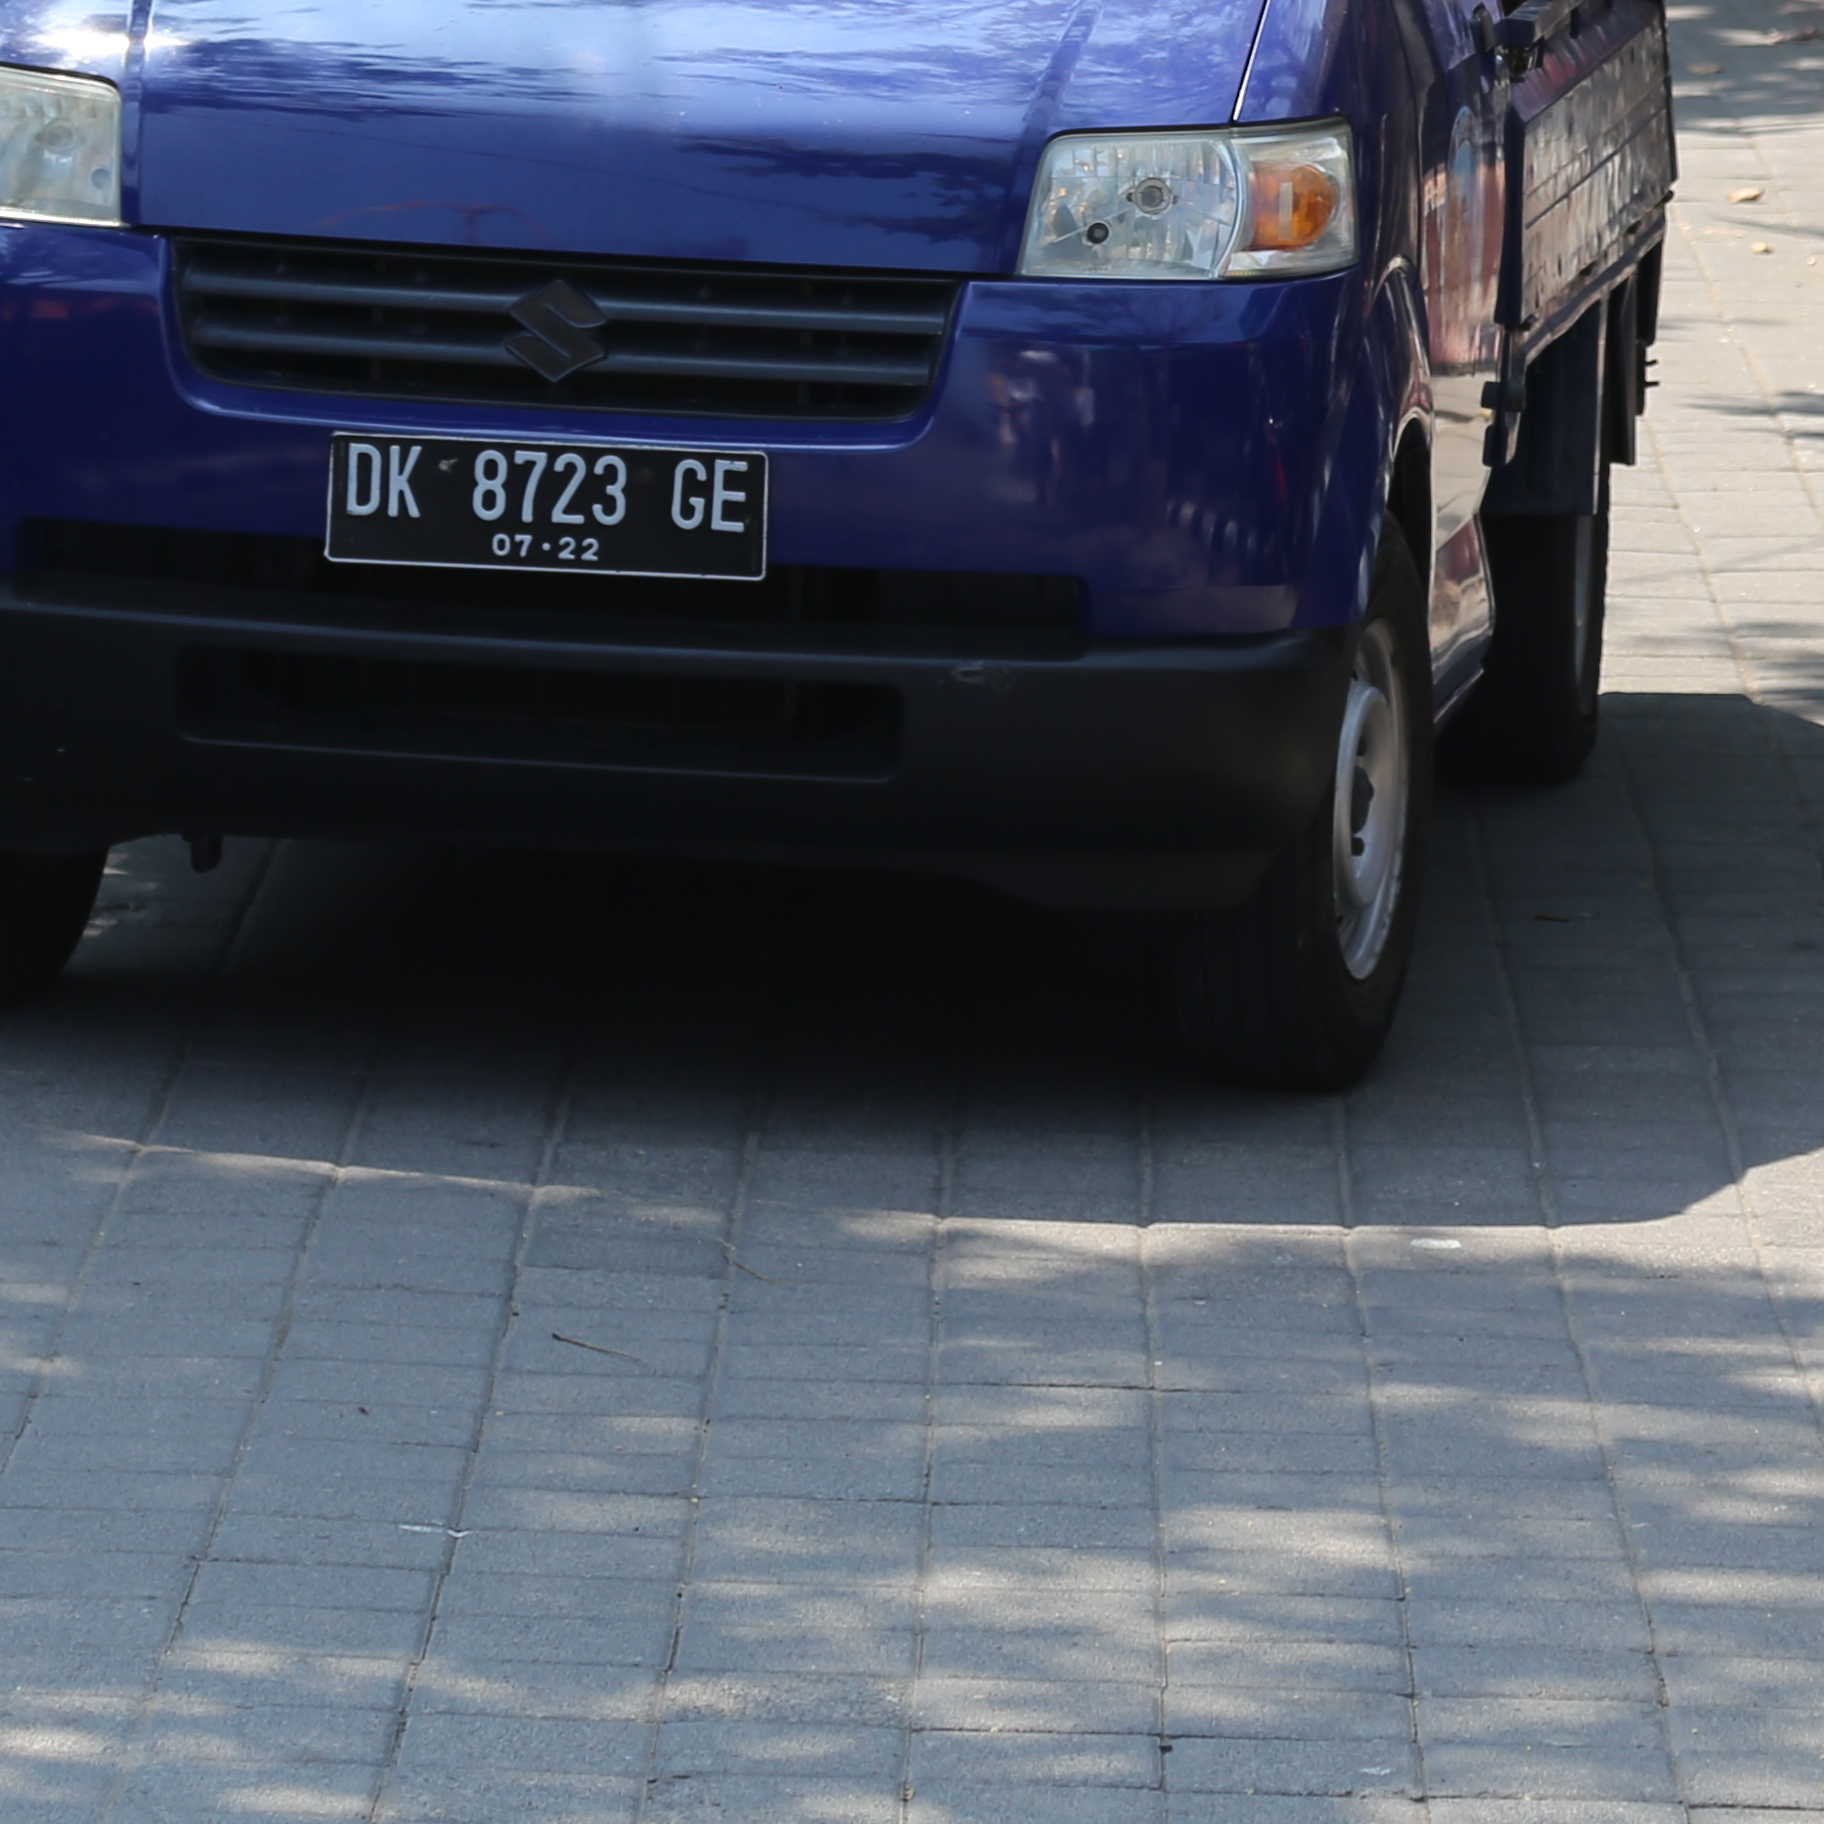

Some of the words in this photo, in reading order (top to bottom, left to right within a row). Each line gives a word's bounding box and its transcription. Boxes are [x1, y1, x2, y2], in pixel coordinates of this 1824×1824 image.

[345, 442, 422, 518] DK
[472, 449, 628, 526] 8723
[670, 459, 749, 533] GE
